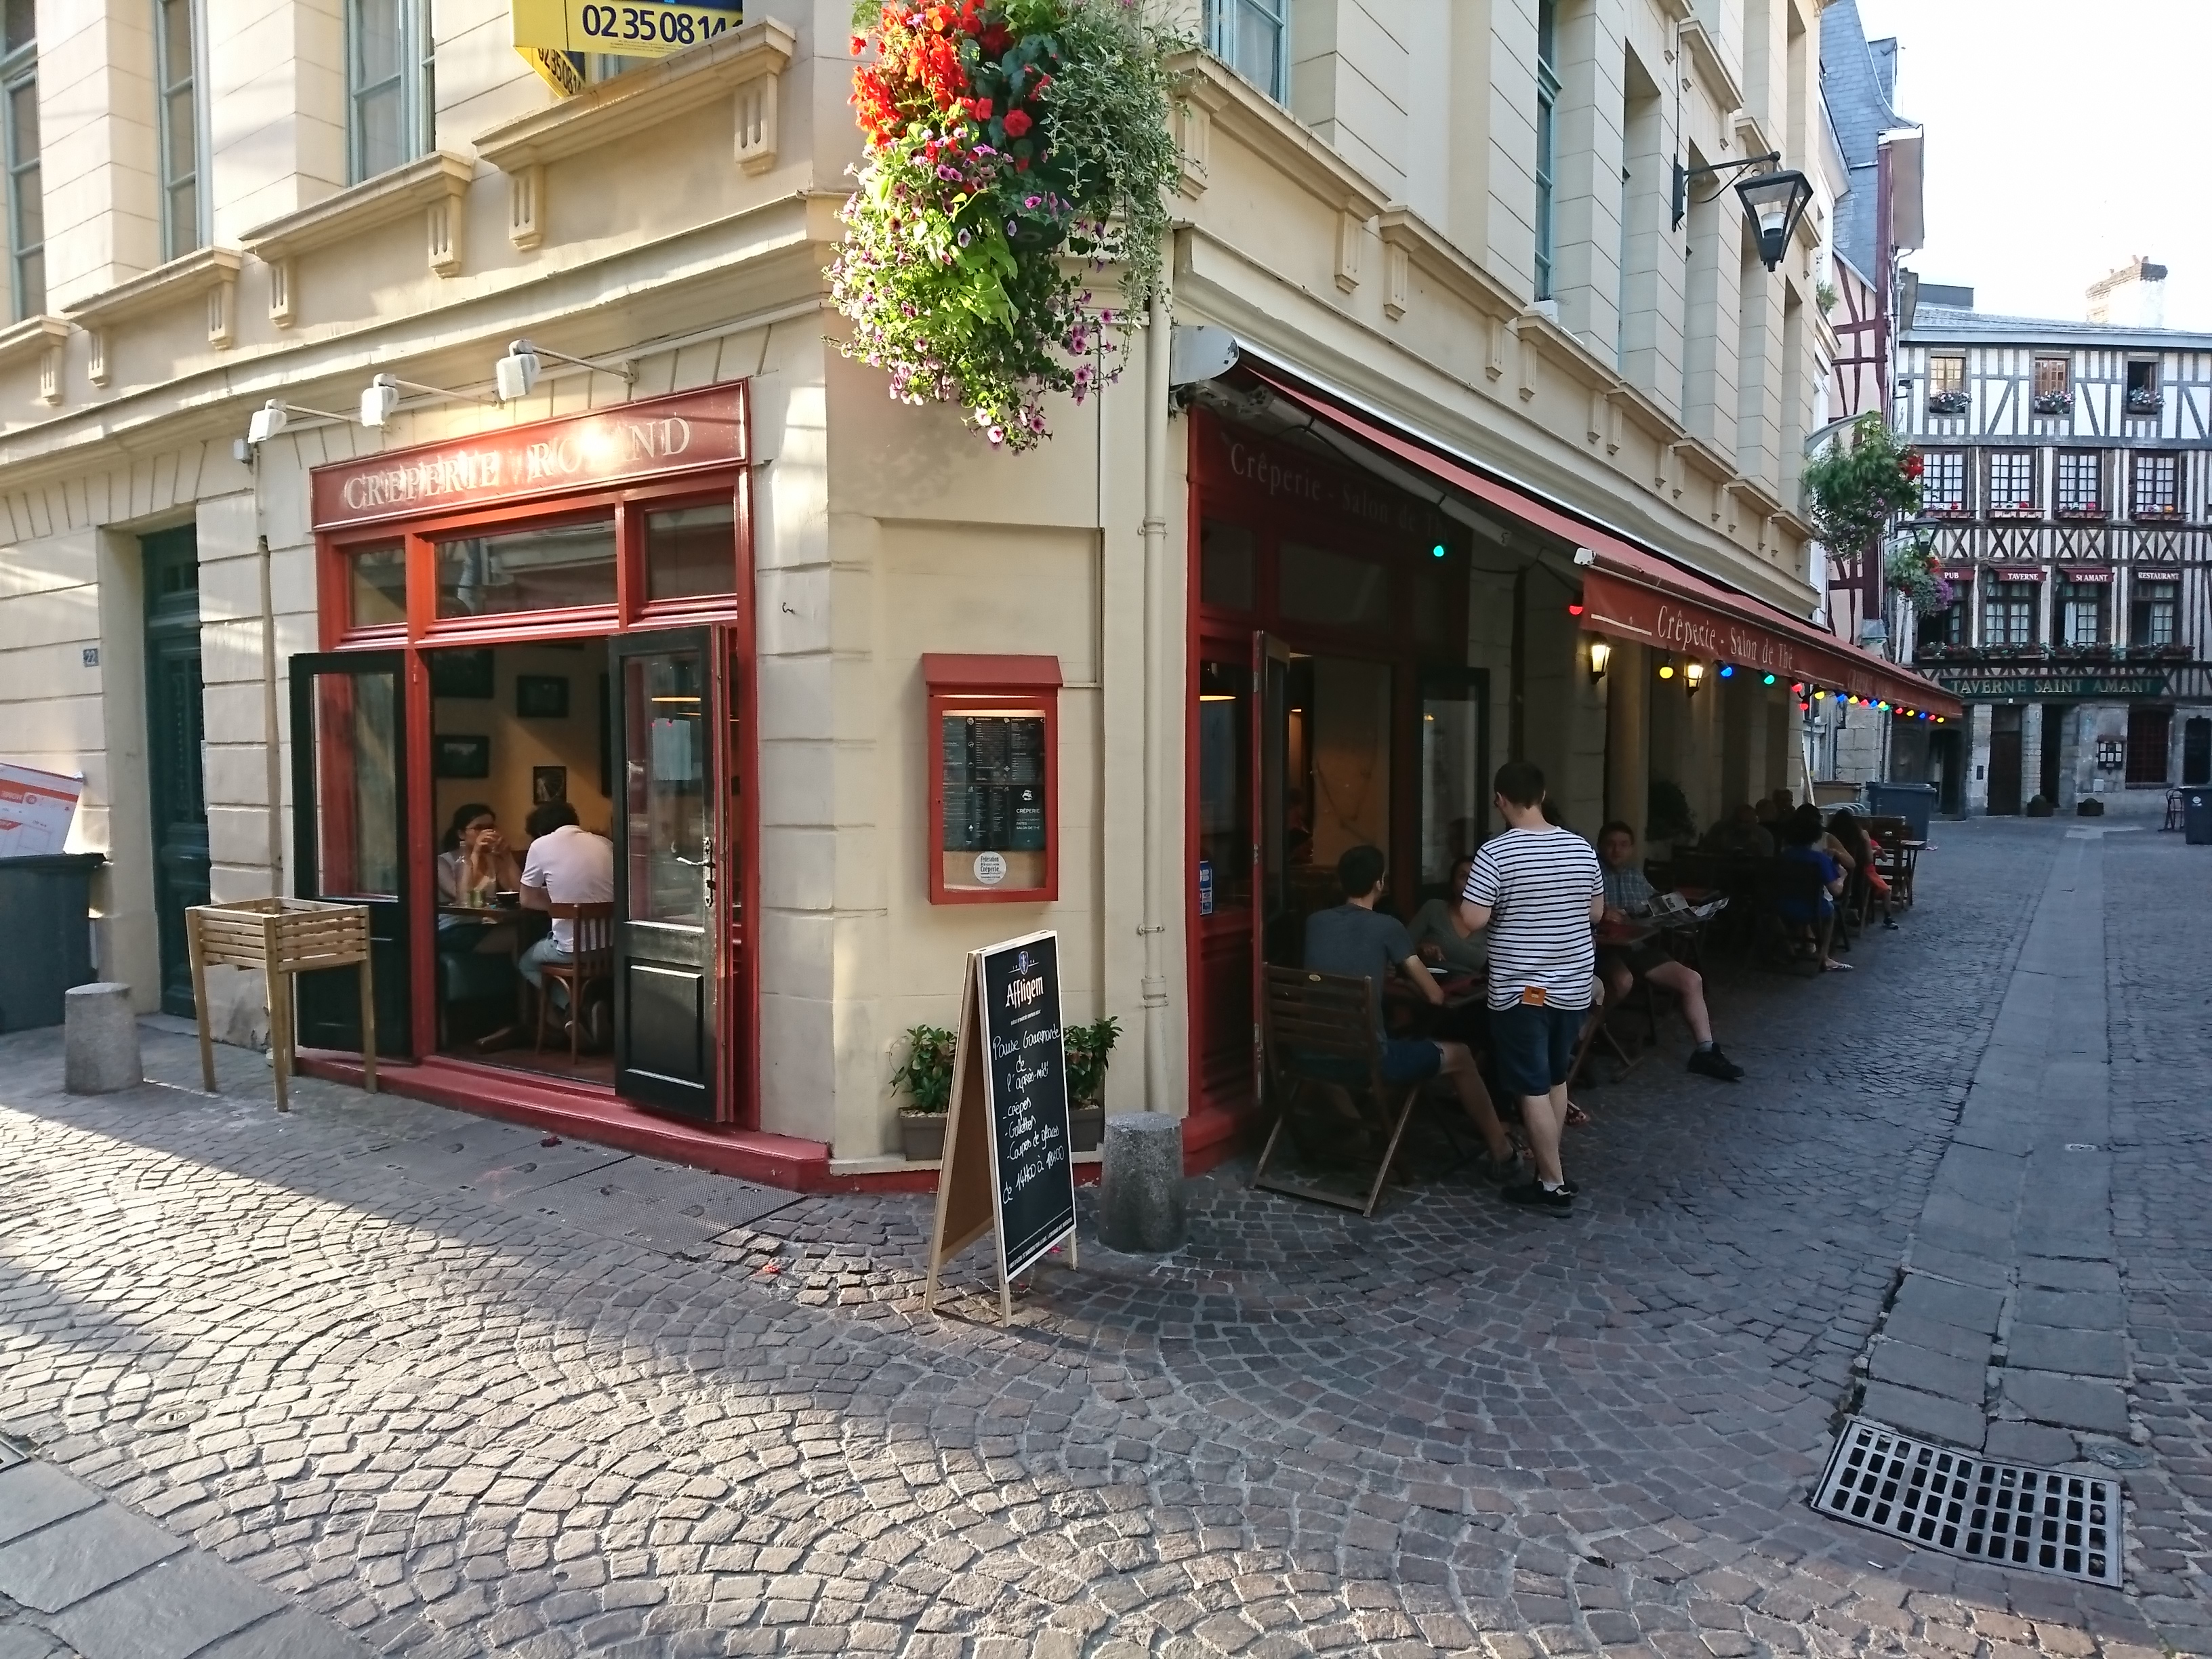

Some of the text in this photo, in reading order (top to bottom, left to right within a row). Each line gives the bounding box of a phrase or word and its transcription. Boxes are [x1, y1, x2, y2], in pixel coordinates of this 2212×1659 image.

[531, 417, 691, 478] ROAND
[1231, 443, 1321, 501] Crêperie
[1343, 485, 1389, 524] Salon
[1399, 504, 1416, 533] de
[1658, 605, 1716, 651] Crêperie
[1730, 627, 1757, 661] Salon
[1762, 638, 1774, 665] de
[1778, 643, 1793, 670] Thé
[1951, 678, 2152, 694] TAVERNE SAINT AMANT
[1005, 976, 1044, 1009] Affligem
[993, 1036, 1020, 1061] Pause
[1016, 1054, 1027, 1073] de
[1033, 1130, 1040, 1147] de
[1041, 1124, 1059, 1150] glaces
[1003, 1181, 1013, 1204] de
[1037, 1154, 1044, 1173] à
